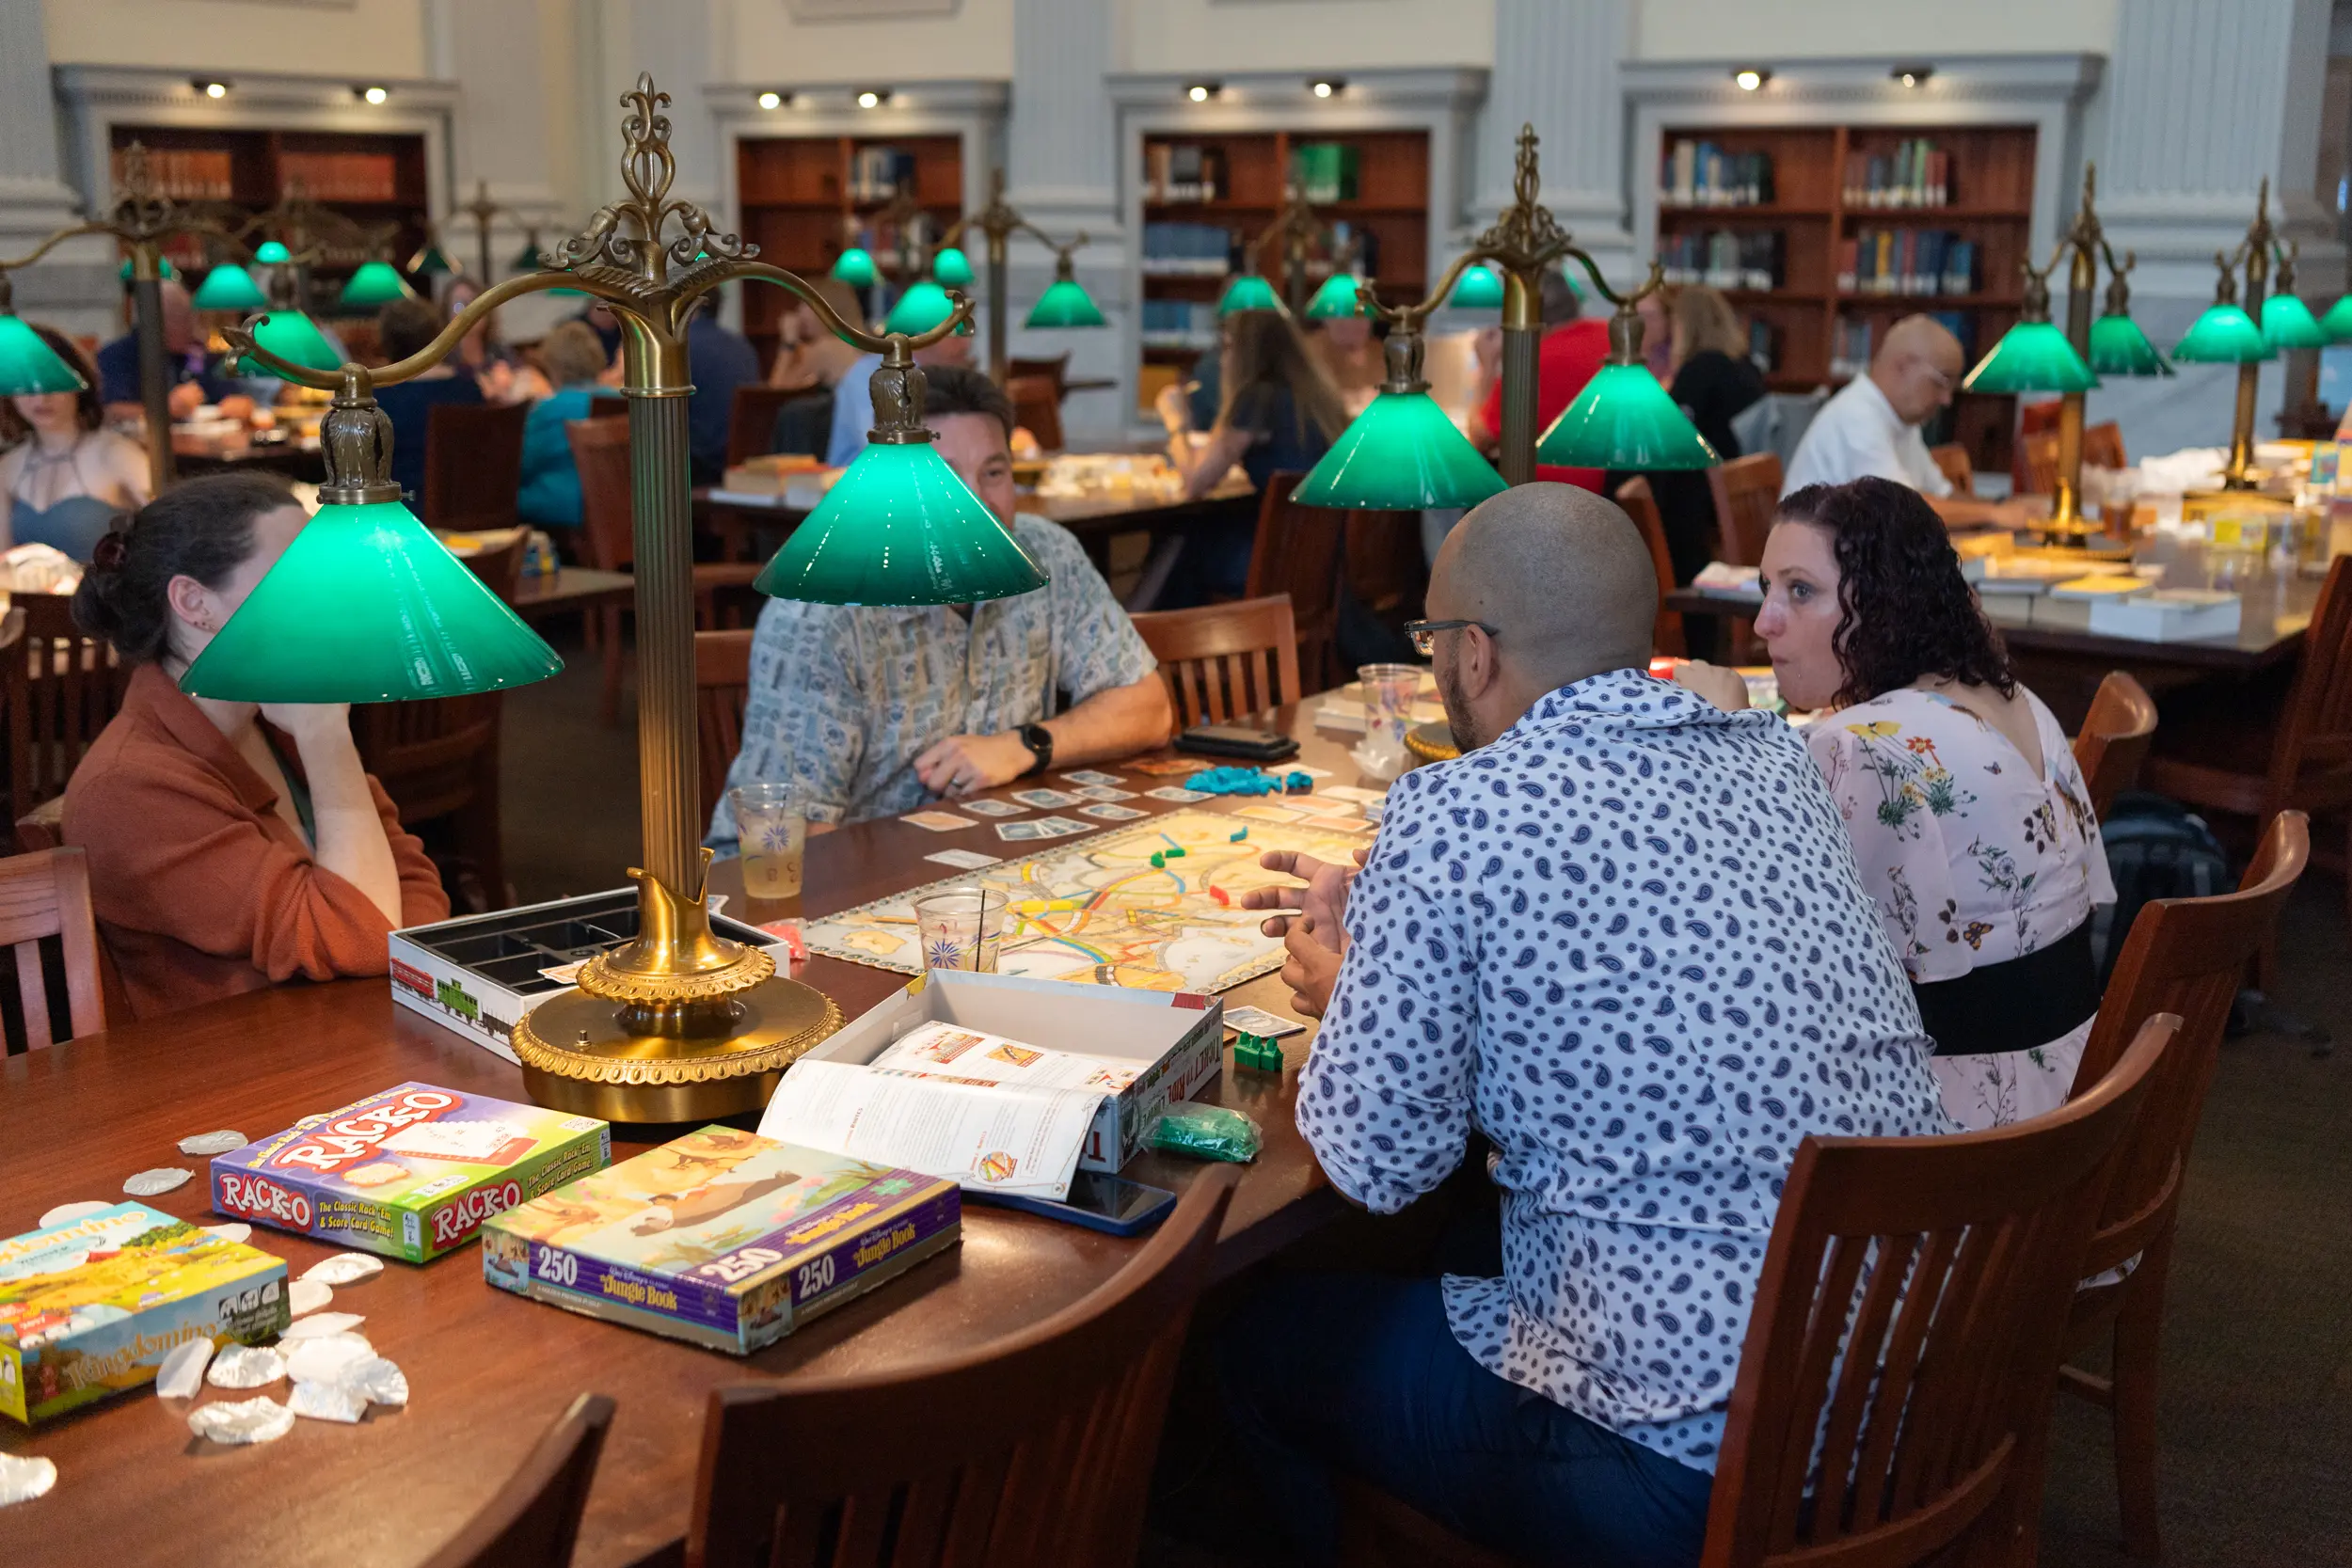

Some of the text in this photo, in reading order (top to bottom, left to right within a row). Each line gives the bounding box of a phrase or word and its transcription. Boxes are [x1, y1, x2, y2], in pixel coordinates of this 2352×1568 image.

[281, 1091, 453, 1171] RACK-O
[528, 1173, 540, 1188] The
[541, 1156, 562, 1178] Classic
[563, 1147, 579, 1164] Rack
[537, 1177, 555, 1196] Score
[556, 1165, 572, 1183] Card
[573, 1155, 594, 1175] Game!
[221, 1176, 311, 1227] RACK-O
[319, 1201, 332, 1213] The
[333, 1200, 358, 1213] Classic
[358, 1202, 376, 1217] Rack
[432, 1181, 522, 1243] RACK-O
[320, 1216, 326, 1228] &
[327, 1215, 349, 1229] Score
[350, 1216, 369, 1231] Card
[370, 1219, 394, 1239] Game!
[857, 1237, 892, 1269] Jungle
[892, 1222, 916, 1250] Book
[538, 1245, 579, 1287] 250
[699, 1247, 784, 1283] 250
[798, 1253, 835, 1299] 250
[604, 1275, 646, 1304] Jungle
[646, 1285, 677, 1311] Book
